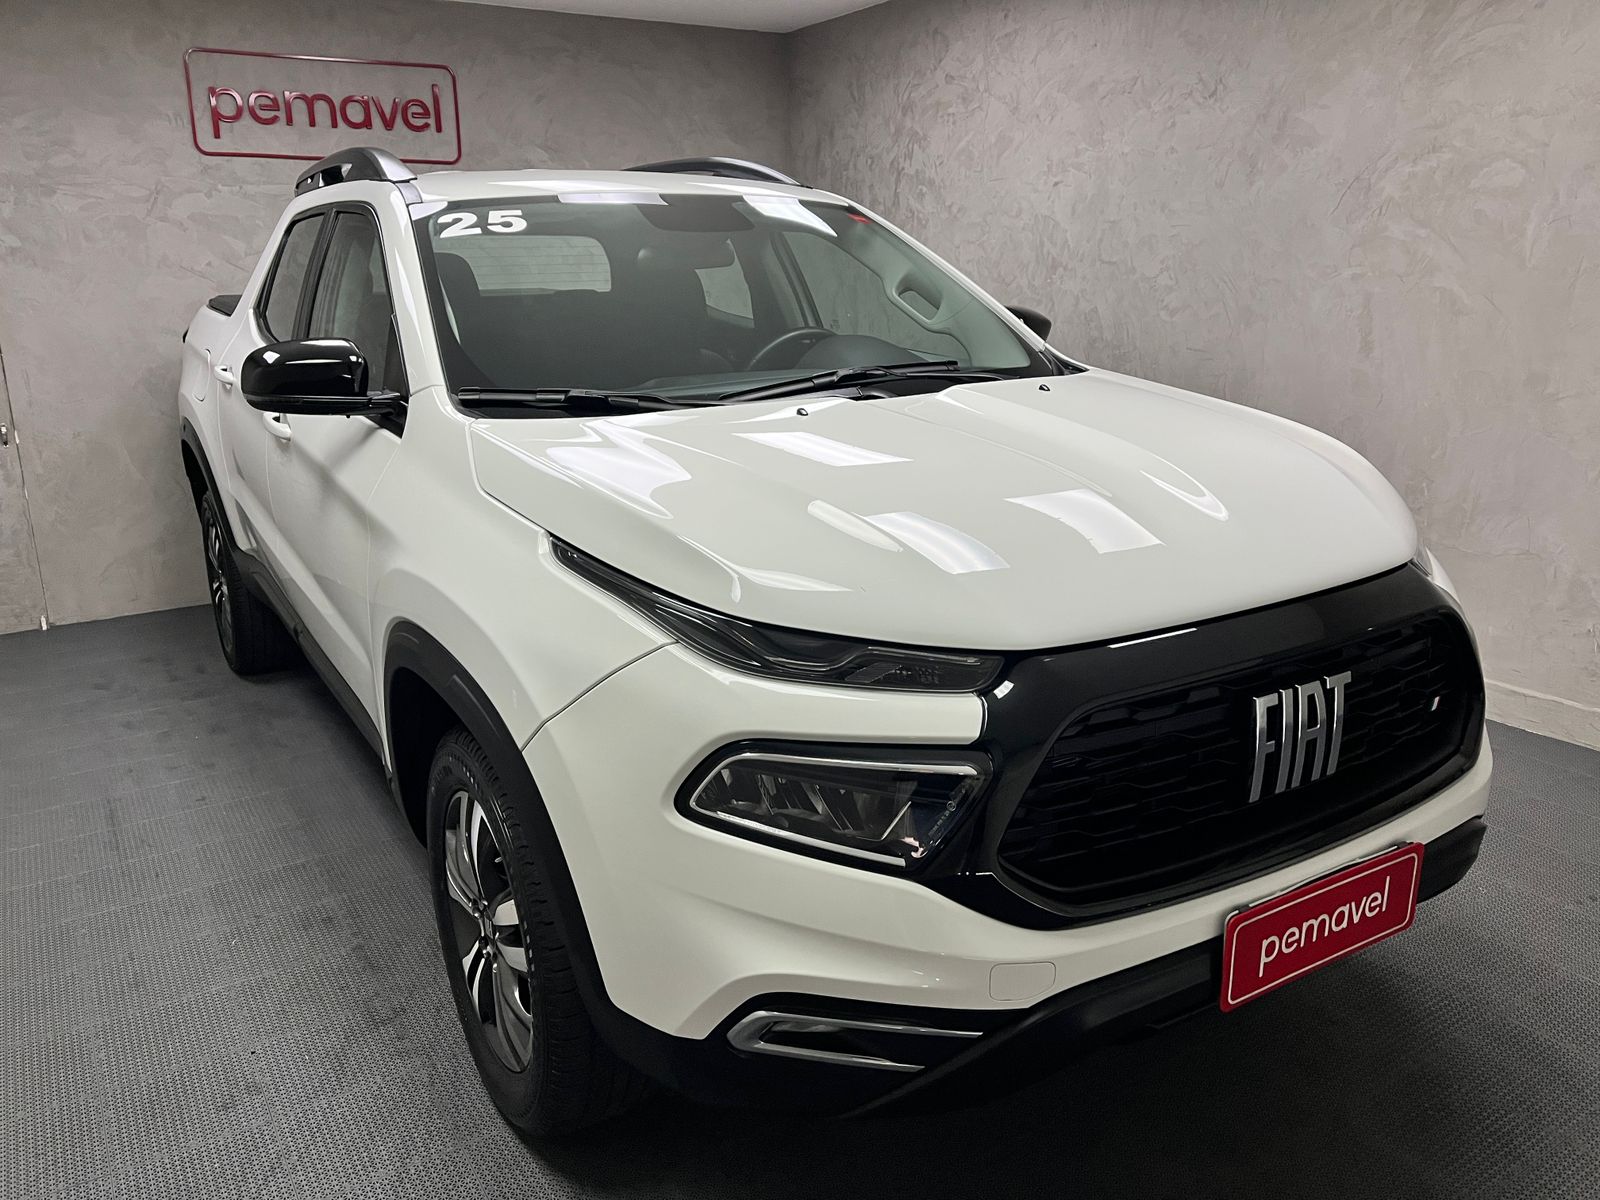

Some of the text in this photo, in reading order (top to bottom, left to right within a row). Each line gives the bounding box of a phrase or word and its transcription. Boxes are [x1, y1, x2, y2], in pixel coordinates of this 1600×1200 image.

[208, 84, 442, 139] pemavel
[437, 210, 528, 239] 25
[1249, 671, 1352, 803] FIAT
[1258, 876, 1390, 978] pemavel
